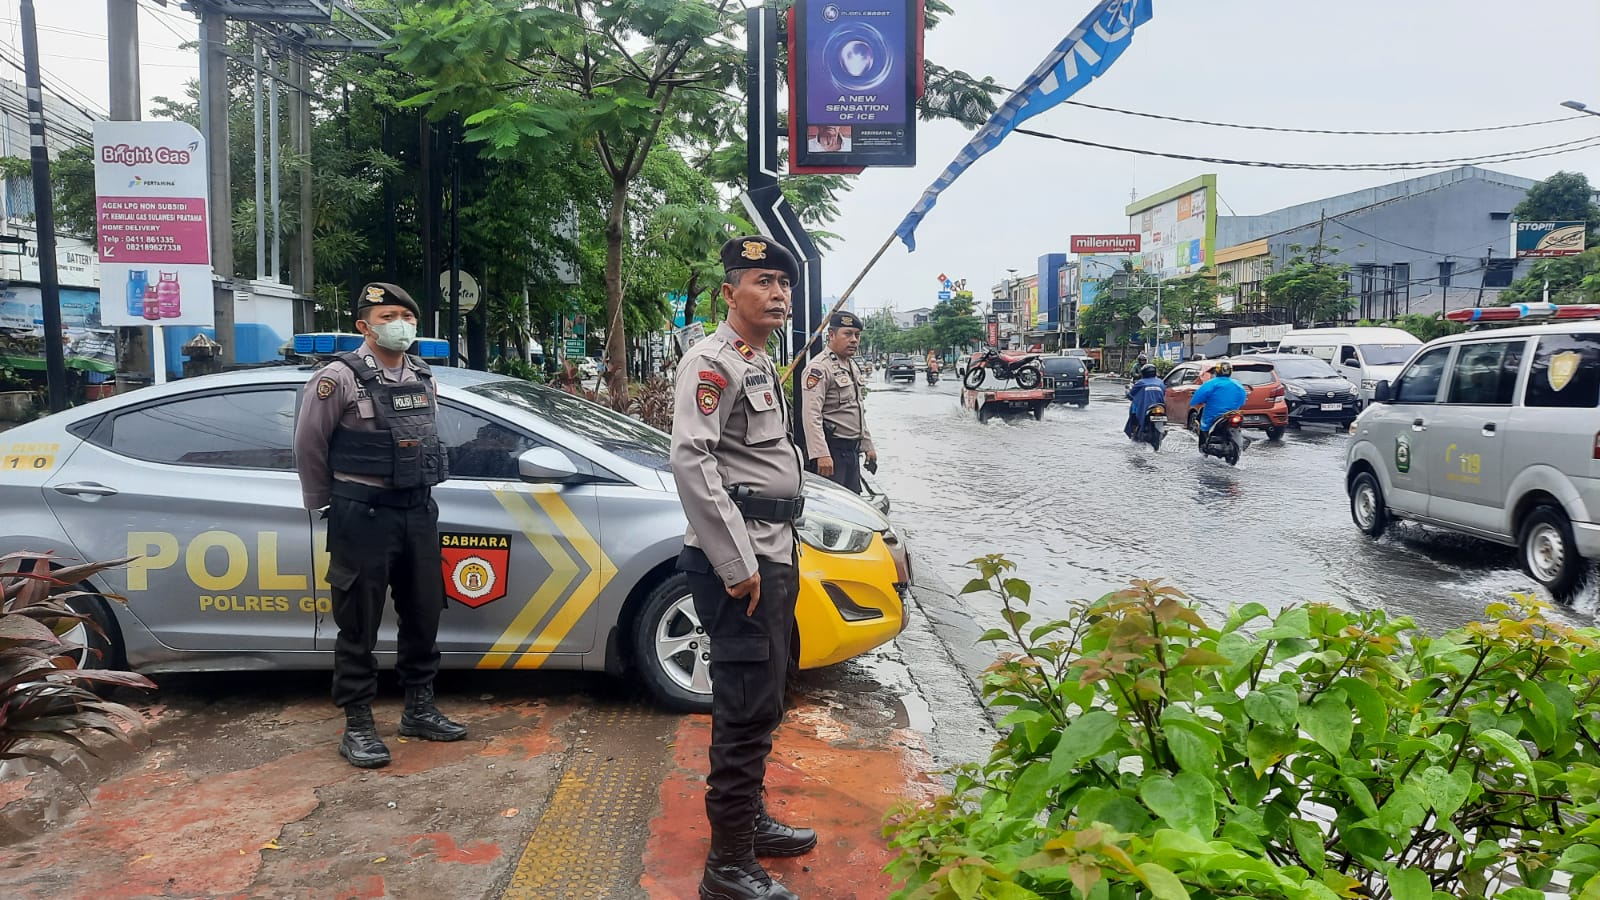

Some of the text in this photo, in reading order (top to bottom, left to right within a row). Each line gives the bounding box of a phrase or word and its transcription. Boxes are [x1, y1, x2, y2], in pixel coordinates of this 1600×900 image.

[849, 95, 877, 103] NEW
[825, 104, 889, 112] SENSATION
[102, 144, 190, 166] Bright Gas
[177, 214, 203, 222] PRATAMA
[1517, 222, 1556, 231] STOP!!!
[103, 235, 119, 244] Telp
[125, 235, 144, 243] 0411
[1076, 236, 1136, 247] millennium
[126, 243, 182, 251] 082189627338
[66, 252, 93, 265] BATTERY
[442, 535, 508, 548] SABHARA
[199, 595, 290, 612] POLRES
